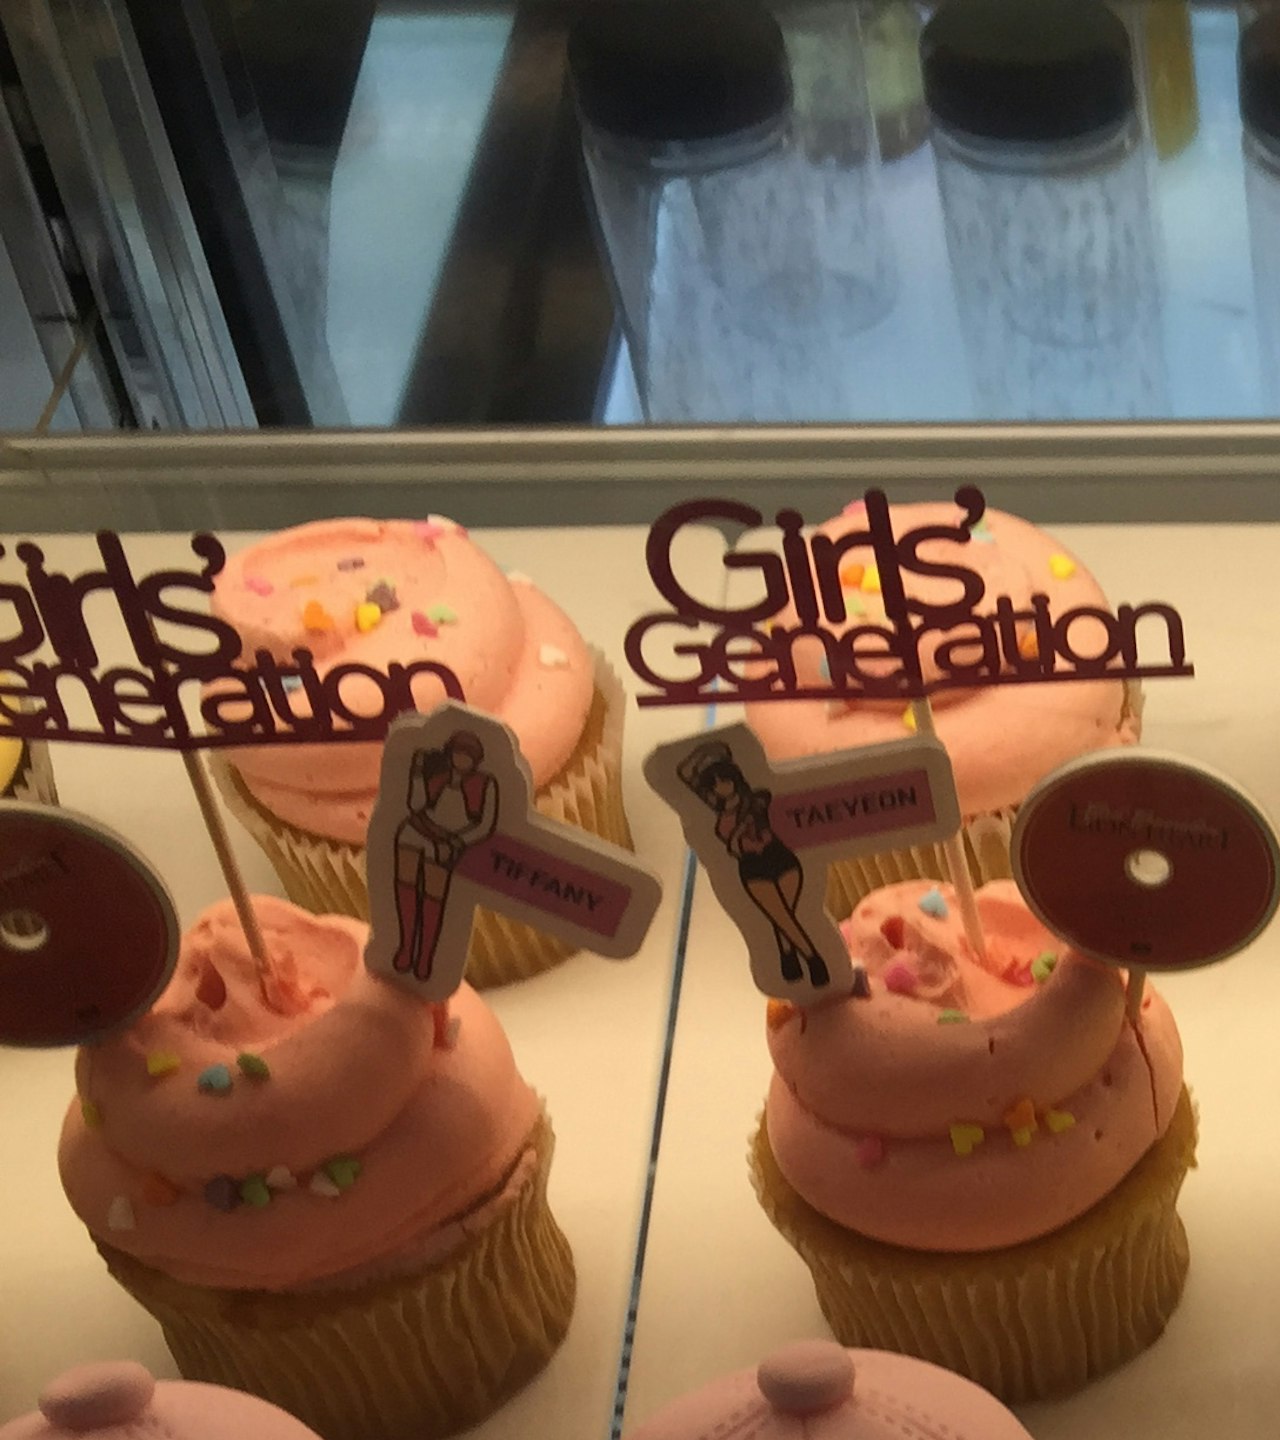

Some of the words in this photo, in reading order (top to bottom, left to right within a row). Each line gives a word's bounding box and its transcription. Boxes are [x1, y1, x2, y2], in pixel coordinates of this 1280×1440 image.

[645, 485, 986, 627] Girls'
[624, 592, 1187, 694] Generation
[0, 648, 466, 739] eneration
[786, 785, 919, 829] TAEYEON
[491, 848, 605, 912] TIFFANY
